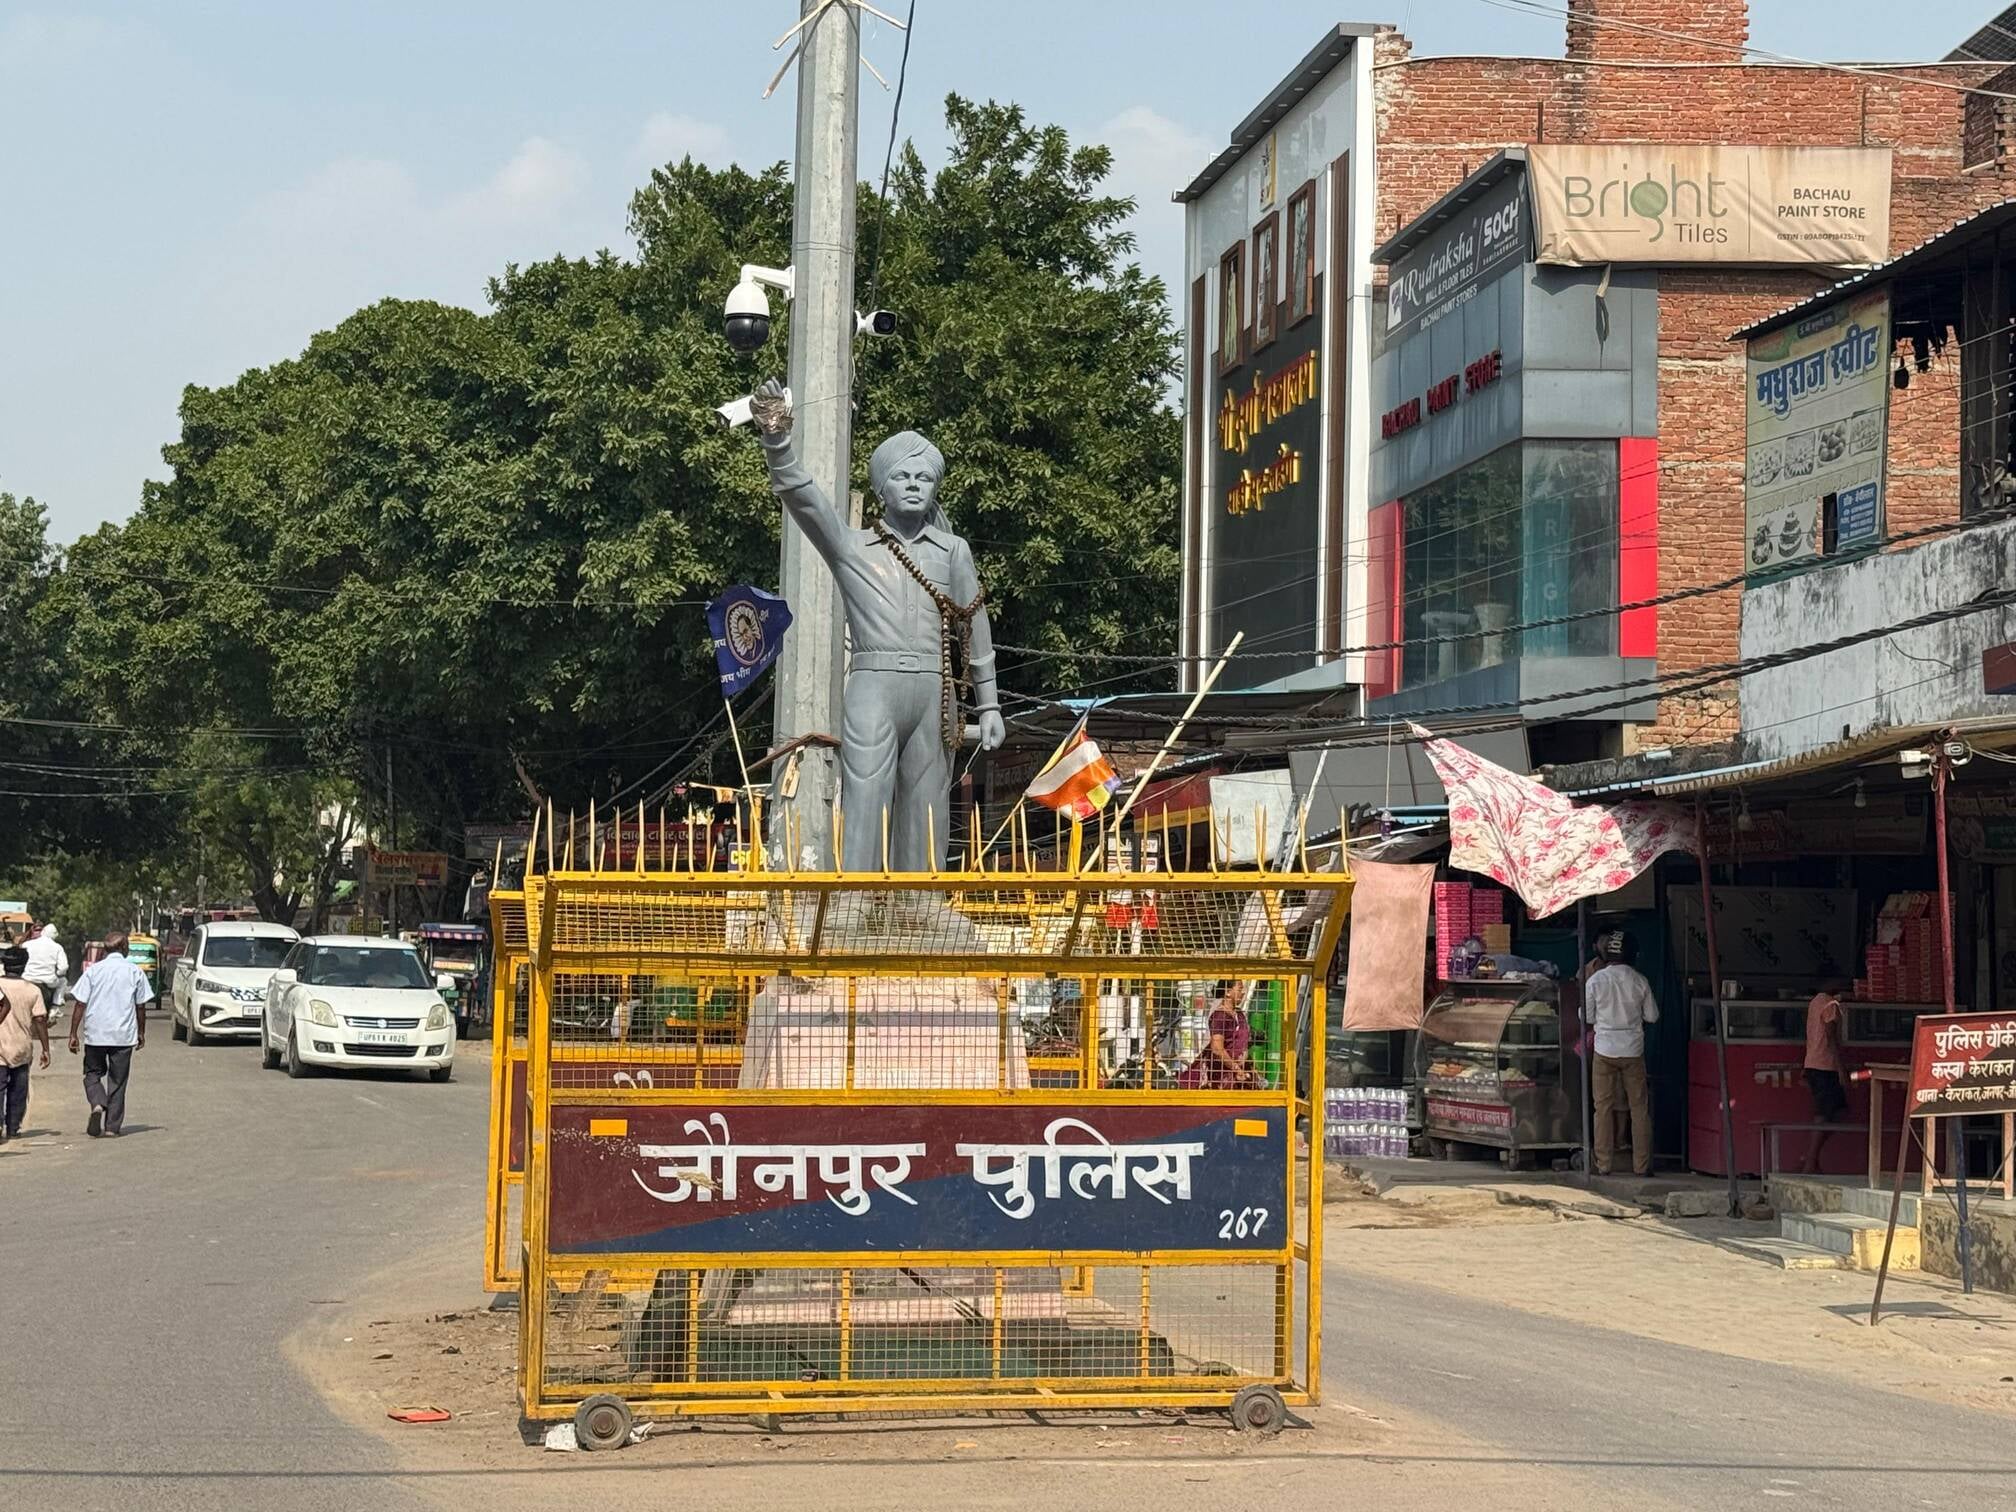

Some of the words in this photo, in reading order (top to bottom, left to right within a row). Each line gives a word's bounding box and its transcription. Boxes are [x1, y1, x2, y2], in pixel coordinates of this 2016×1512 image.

[1564, 163, 1728, 243] Bright
[1793, 188, 1851, 202] BACHAU
[1777, 205, 1819, 219] PAINT
[1823, 205, 1866, 219] STORE
[1674, 222, 1728, 244] Tiles
[1404, 231, 1474, 306] Rudraksha
[1756, 348, 1828, 418] मधुराज
[1830, 322, 1879, 383] स्वीट
[1934, 1024, 1984, 1058] पुलिस
[1968, 1056, 2015, 1078] केराकत
[631, 1112, 926, 1216] जौनपुर
[956, 1117, 1205, 1220] पुलिस
[1219, 1208, 1269, 1240] 267
